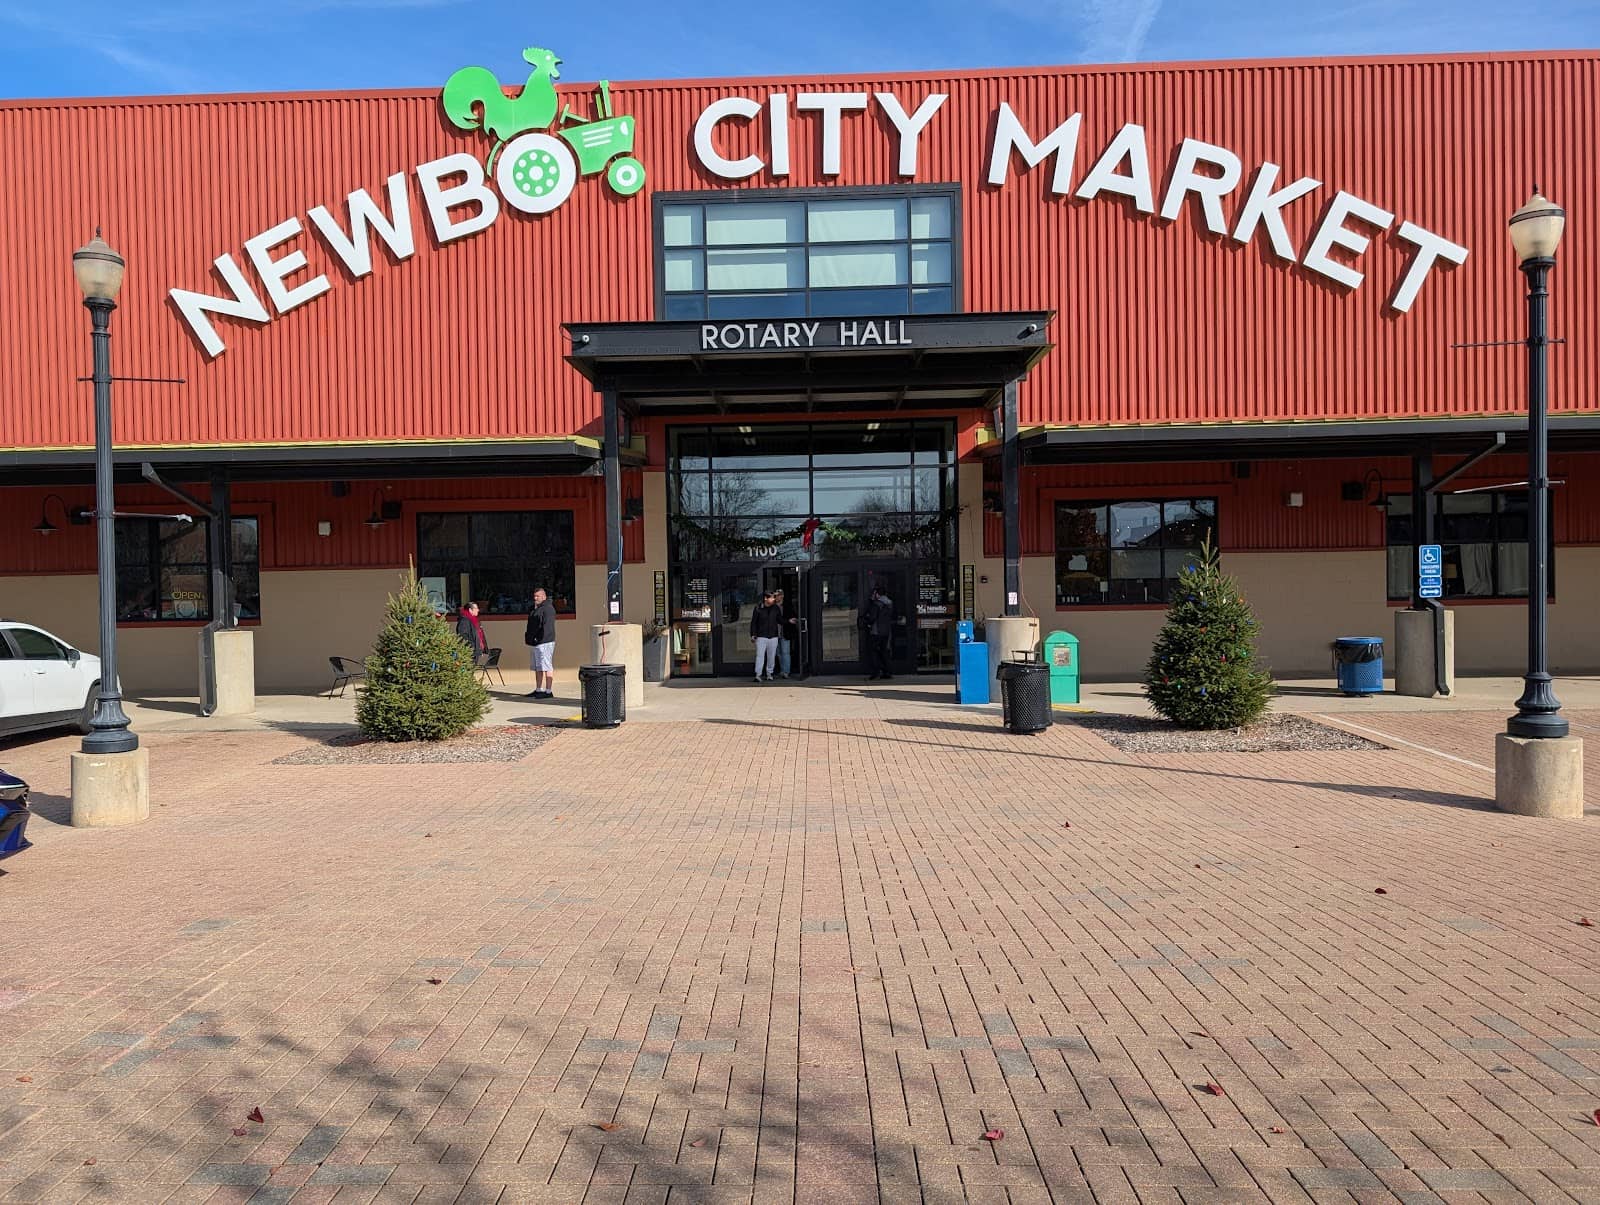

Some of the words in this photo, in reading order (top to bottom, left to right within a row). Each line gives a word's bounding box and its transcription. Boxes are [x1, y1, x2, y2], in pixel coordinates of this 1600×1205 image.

[168, 132, 577, 358] NEWBO
[694, 92, 949, 179] CITY
[988, 101, 1469, 313] MARKET
[702, 322, 820, 349] ROTARY
[840, 320, 912, 346] HALL
[171, 591, 201, 600] OPEN
